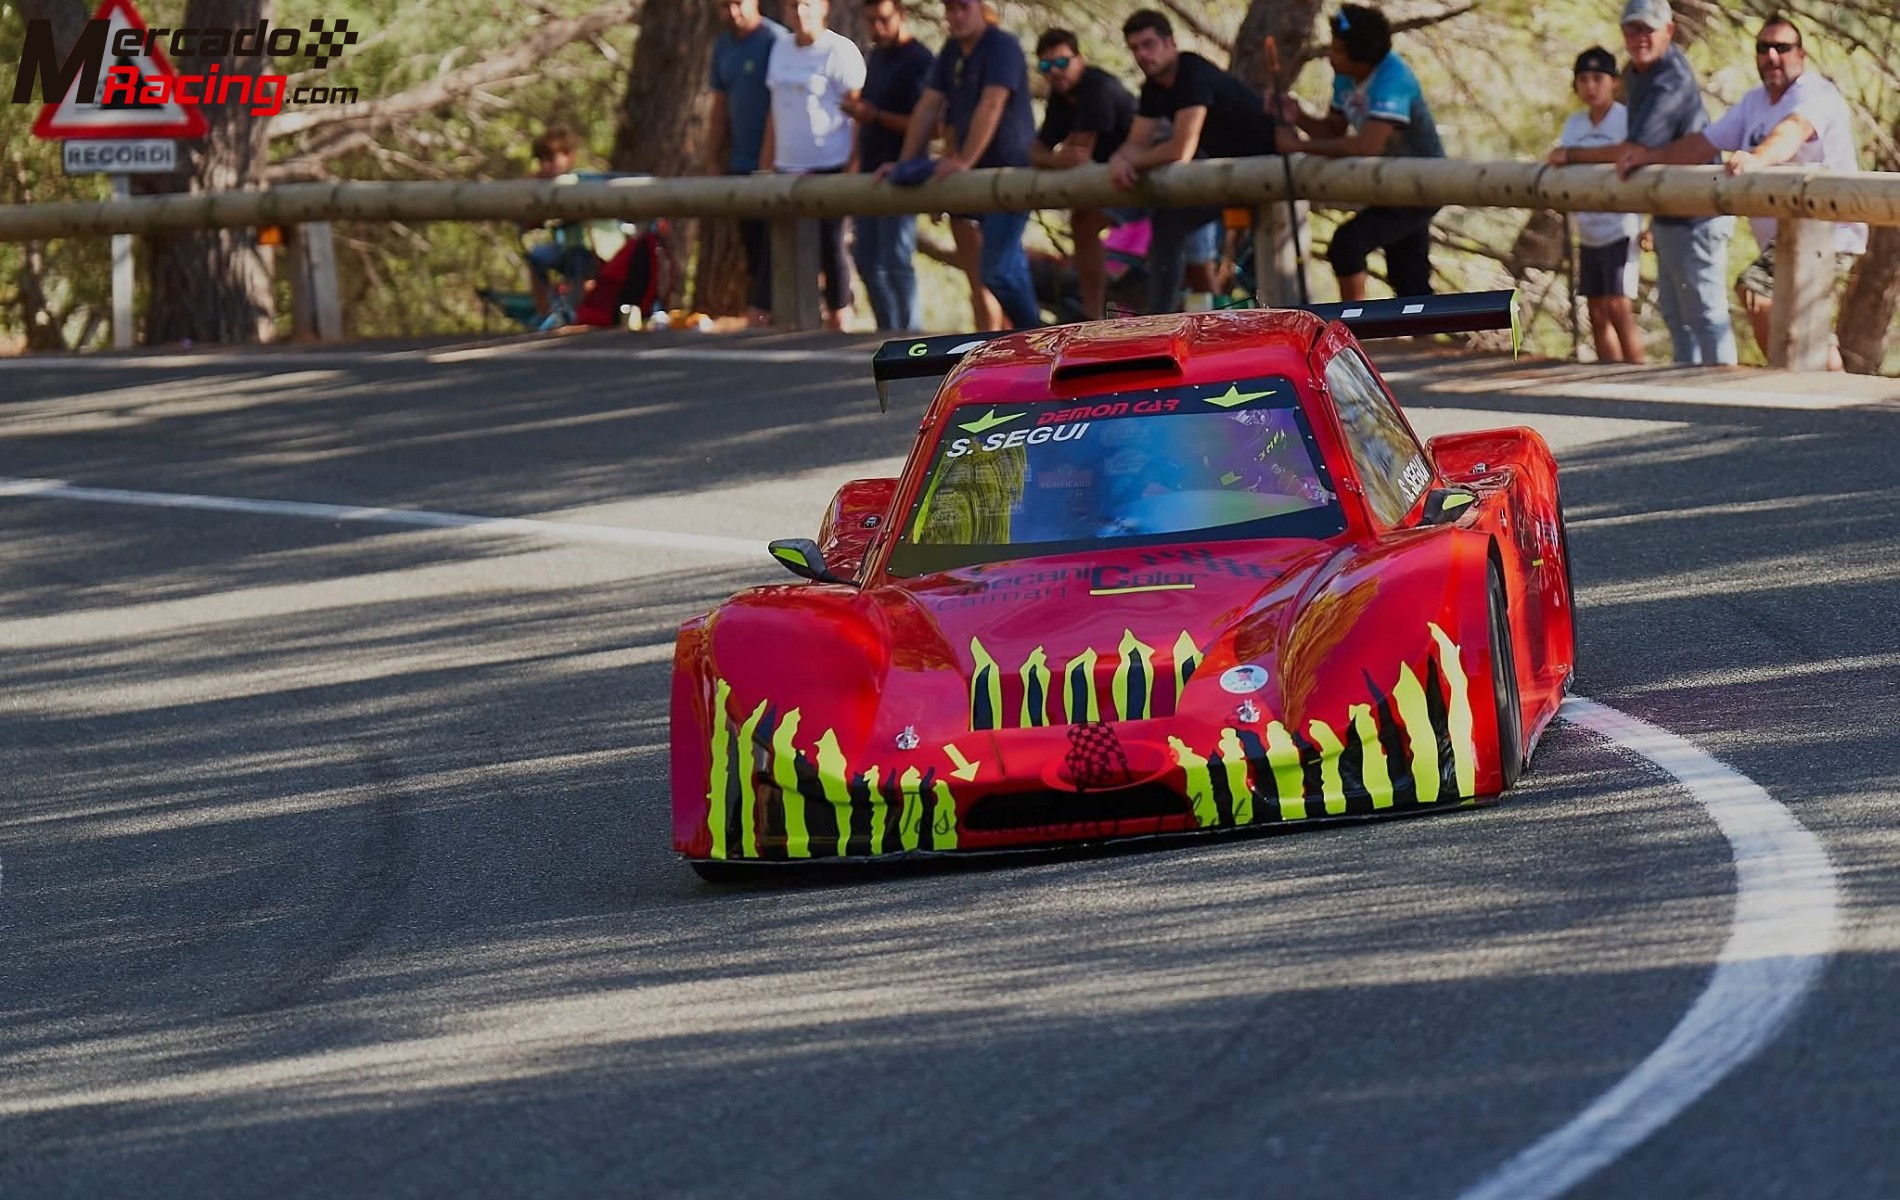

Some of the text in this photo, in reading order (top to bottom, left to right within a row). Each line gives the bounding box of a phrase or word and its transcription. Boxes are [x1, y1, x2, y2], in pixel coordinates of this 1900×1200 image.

[67, 146, 171, 165] RECORDI
[908, 343, 928, 357] G
[1037, 399, 1180, 425] DEMON CAR
[946, 438, 974, 458] S.
[982, 422, 1090, 452] SEGUI
[1402, 454, 1430, 496] SEGUI
